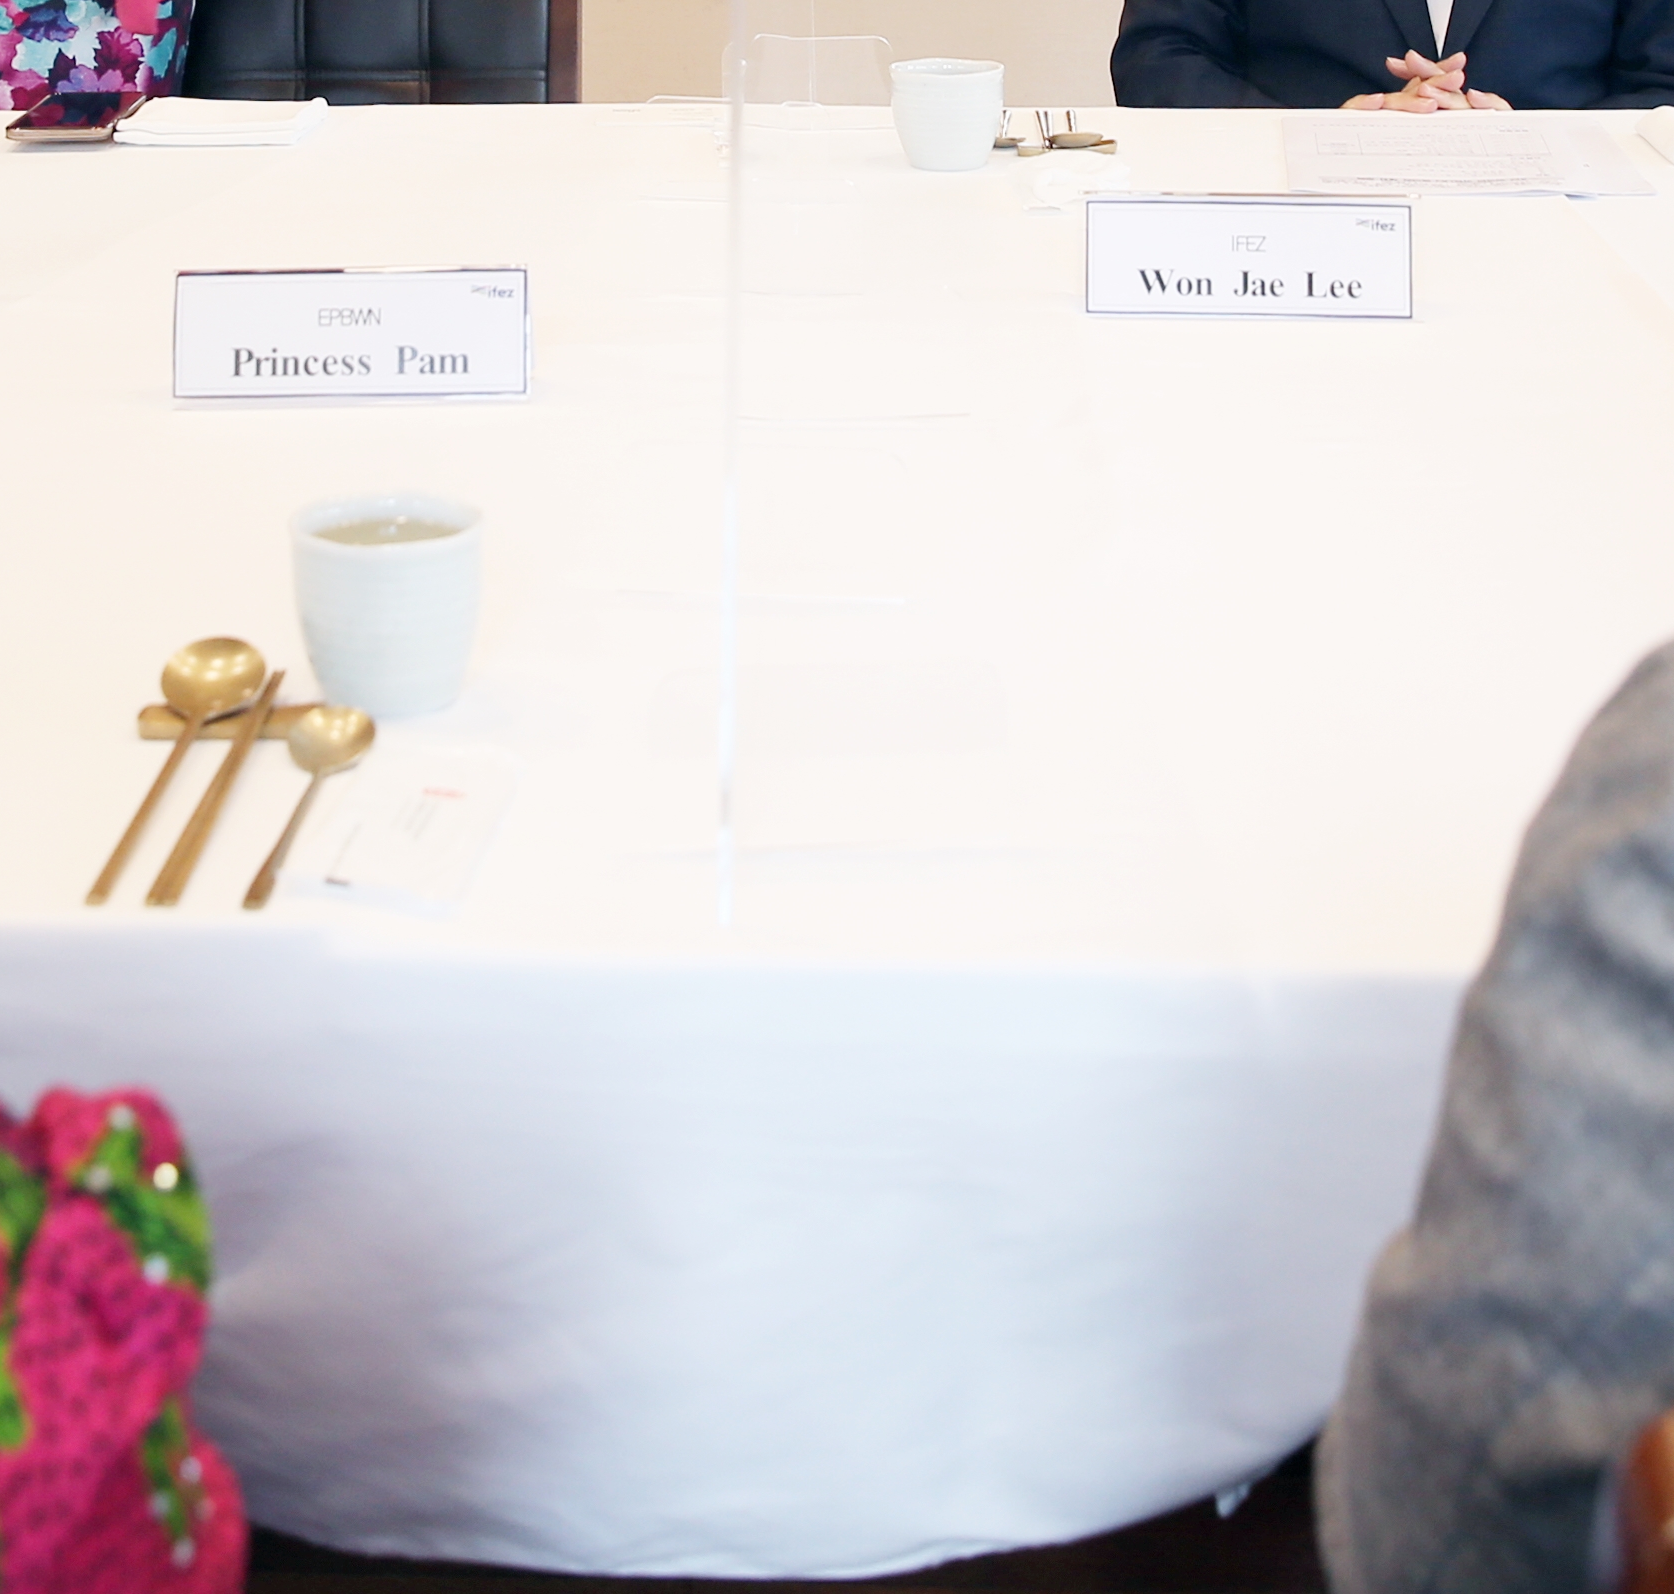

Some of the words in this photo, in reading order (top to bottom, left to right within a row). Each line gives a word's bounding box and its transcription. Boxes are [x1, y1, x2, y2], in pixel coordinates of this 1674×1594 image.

[1370, 219, 1396, 232] ifez
[1231, 235, 1267, 252] IFEZ
[487, 286, 515, 299] ifez
[1137, 268, 1214, 297] Won
[1233, 270, 1284, 297] Jae
[1304, 271, 1363, 299] Lee
[318, 308, 381, 327] EPBWN
[231, 347, 372, 377] Princess
[395, 344, 470, 375] Pam
